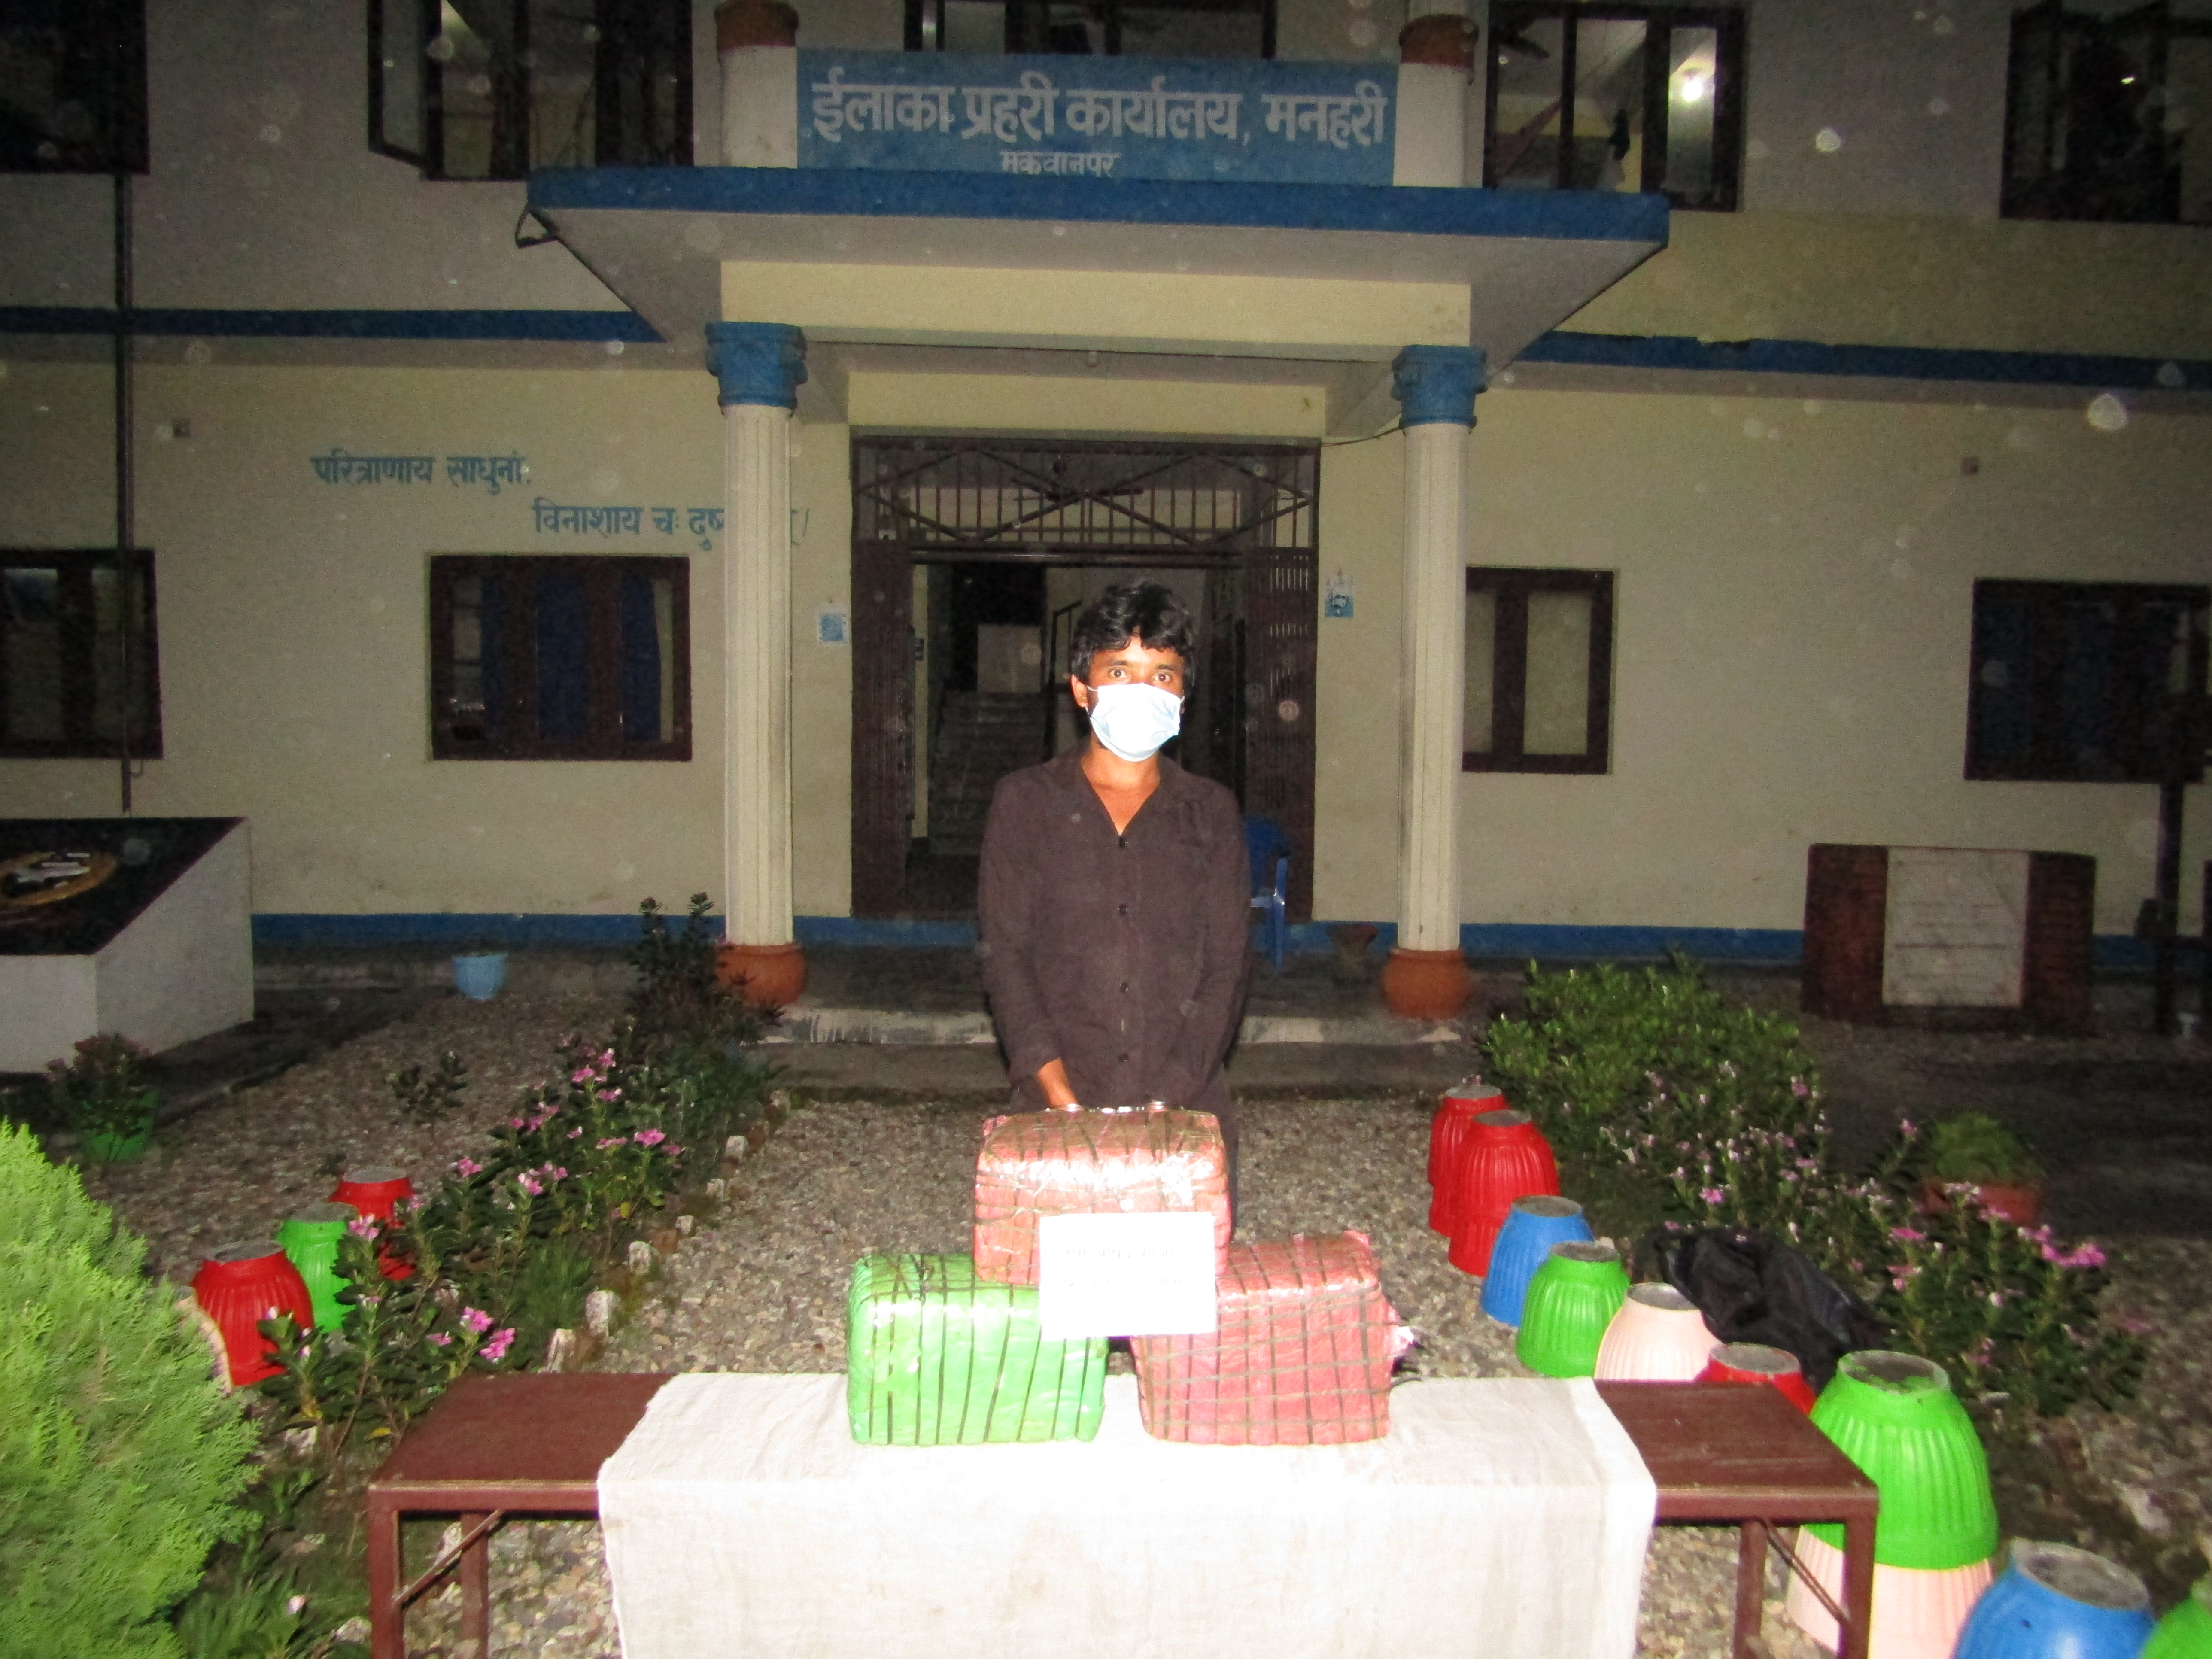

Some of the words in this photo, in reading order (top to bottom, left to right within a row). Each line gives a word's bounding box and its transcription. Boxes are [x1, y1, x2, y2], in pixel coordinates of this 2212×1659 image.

[812, 66, 955, 142] ईलाका
[961, 70, 1060, 143] प्रहरी
[1261, 79, 1388, 149] मनहरी
[310, 448, 436, 487] परित्राणाय
[532, 497, 643, 539] विनाशाय
